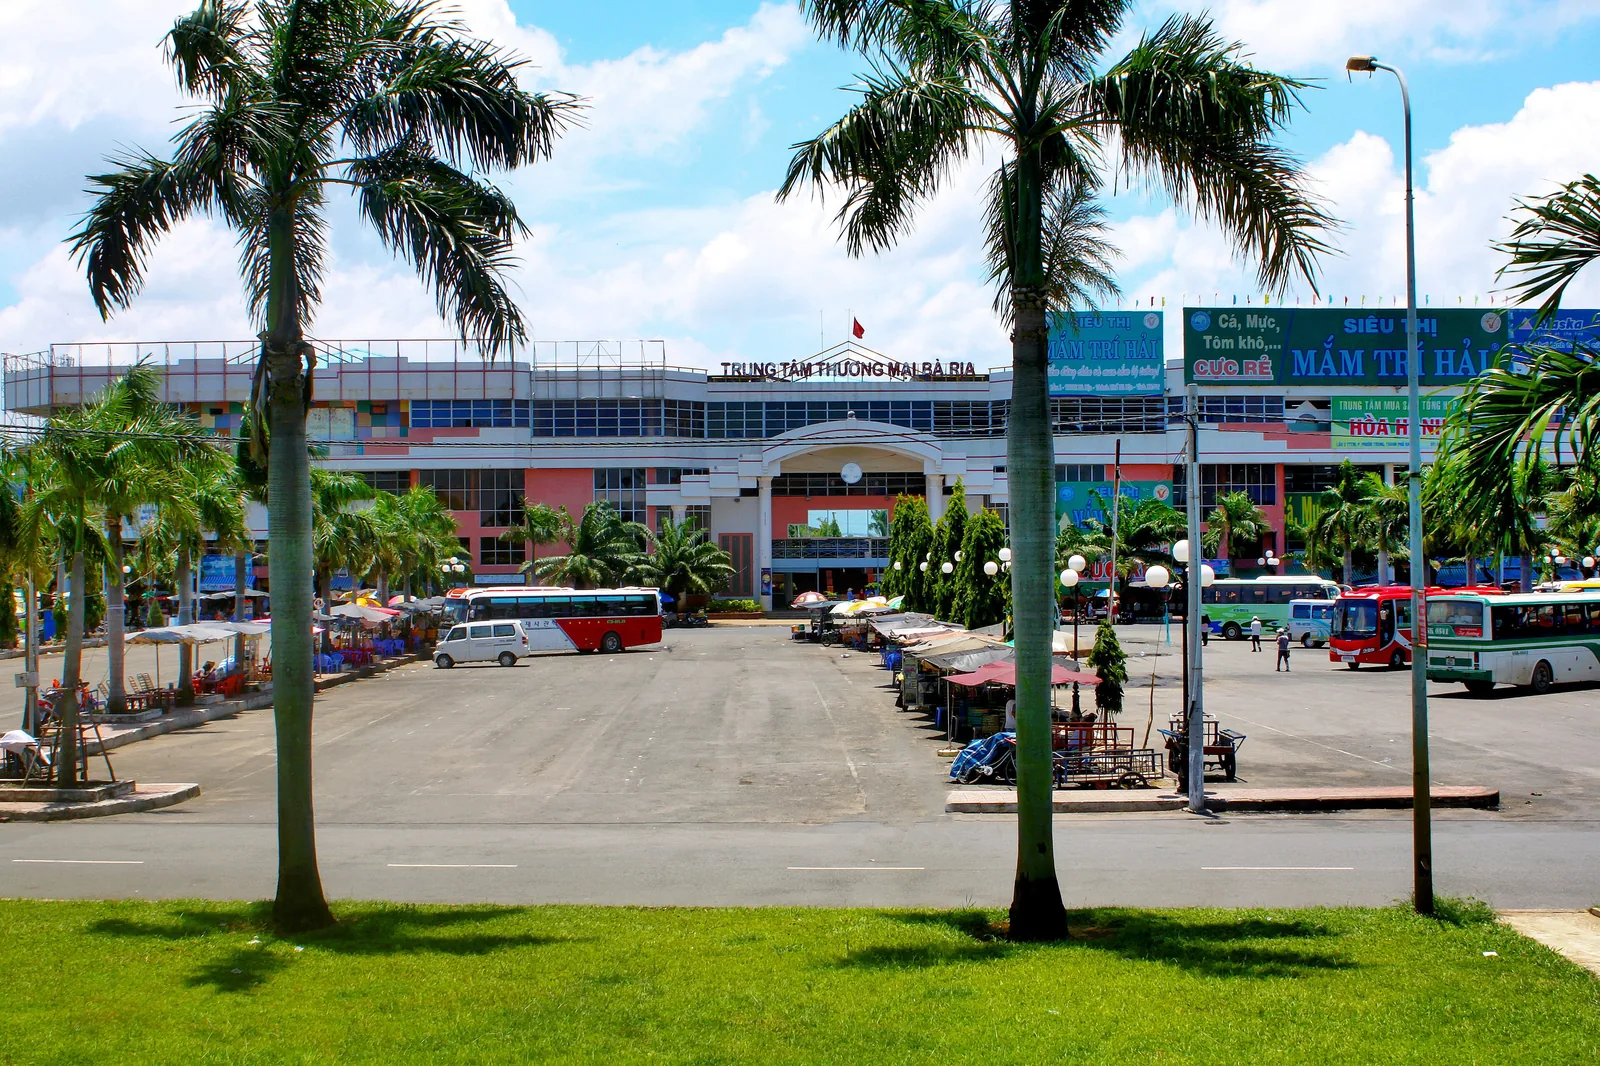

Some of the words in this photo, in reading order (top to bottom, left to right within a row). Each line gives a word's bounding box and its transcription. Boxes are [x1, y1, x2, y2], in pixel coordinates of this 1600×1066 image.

[1107, 316, 1131, 330] THỊ
[1218, 313, 1242, 331] Cá,
[1245, 314, 1280, 333] Mực,
[1343, 315, 1394, 334] SIÊU
[1400, 317, 1438, 337] THỊ
[1089, 334, 1120, 360] TRÍ
[1124, 332, 1159, 360] HẢI
[1203, 335, 1235, 349] Tôm
[1291, 334, 1365, 376] MẮM
[1373, 340, 1426, 376] TRÍ
[1434, 337, 1491, 376] HẢI
[720, 362, 777, 377] TRUNG
[780, 358, 813, 377] TÂM
[816, 361, 884, 377] THƯƠNG
[921, 358, 944, 377] BÀ
[1193, 356, 1240, 380] CỰC
[1243, 354, 1273, 377] RẺ
[1339, 400, 1363, 410] TRUNG
[1365, 399, 1383, 410] TÂM
[1383, 401, 1401, 410] MUA
[1442, 400, 1458, 412] HP
[1348, 413, 1390, 437] HÒA
[1395, 417, 1447, 437] HNH
